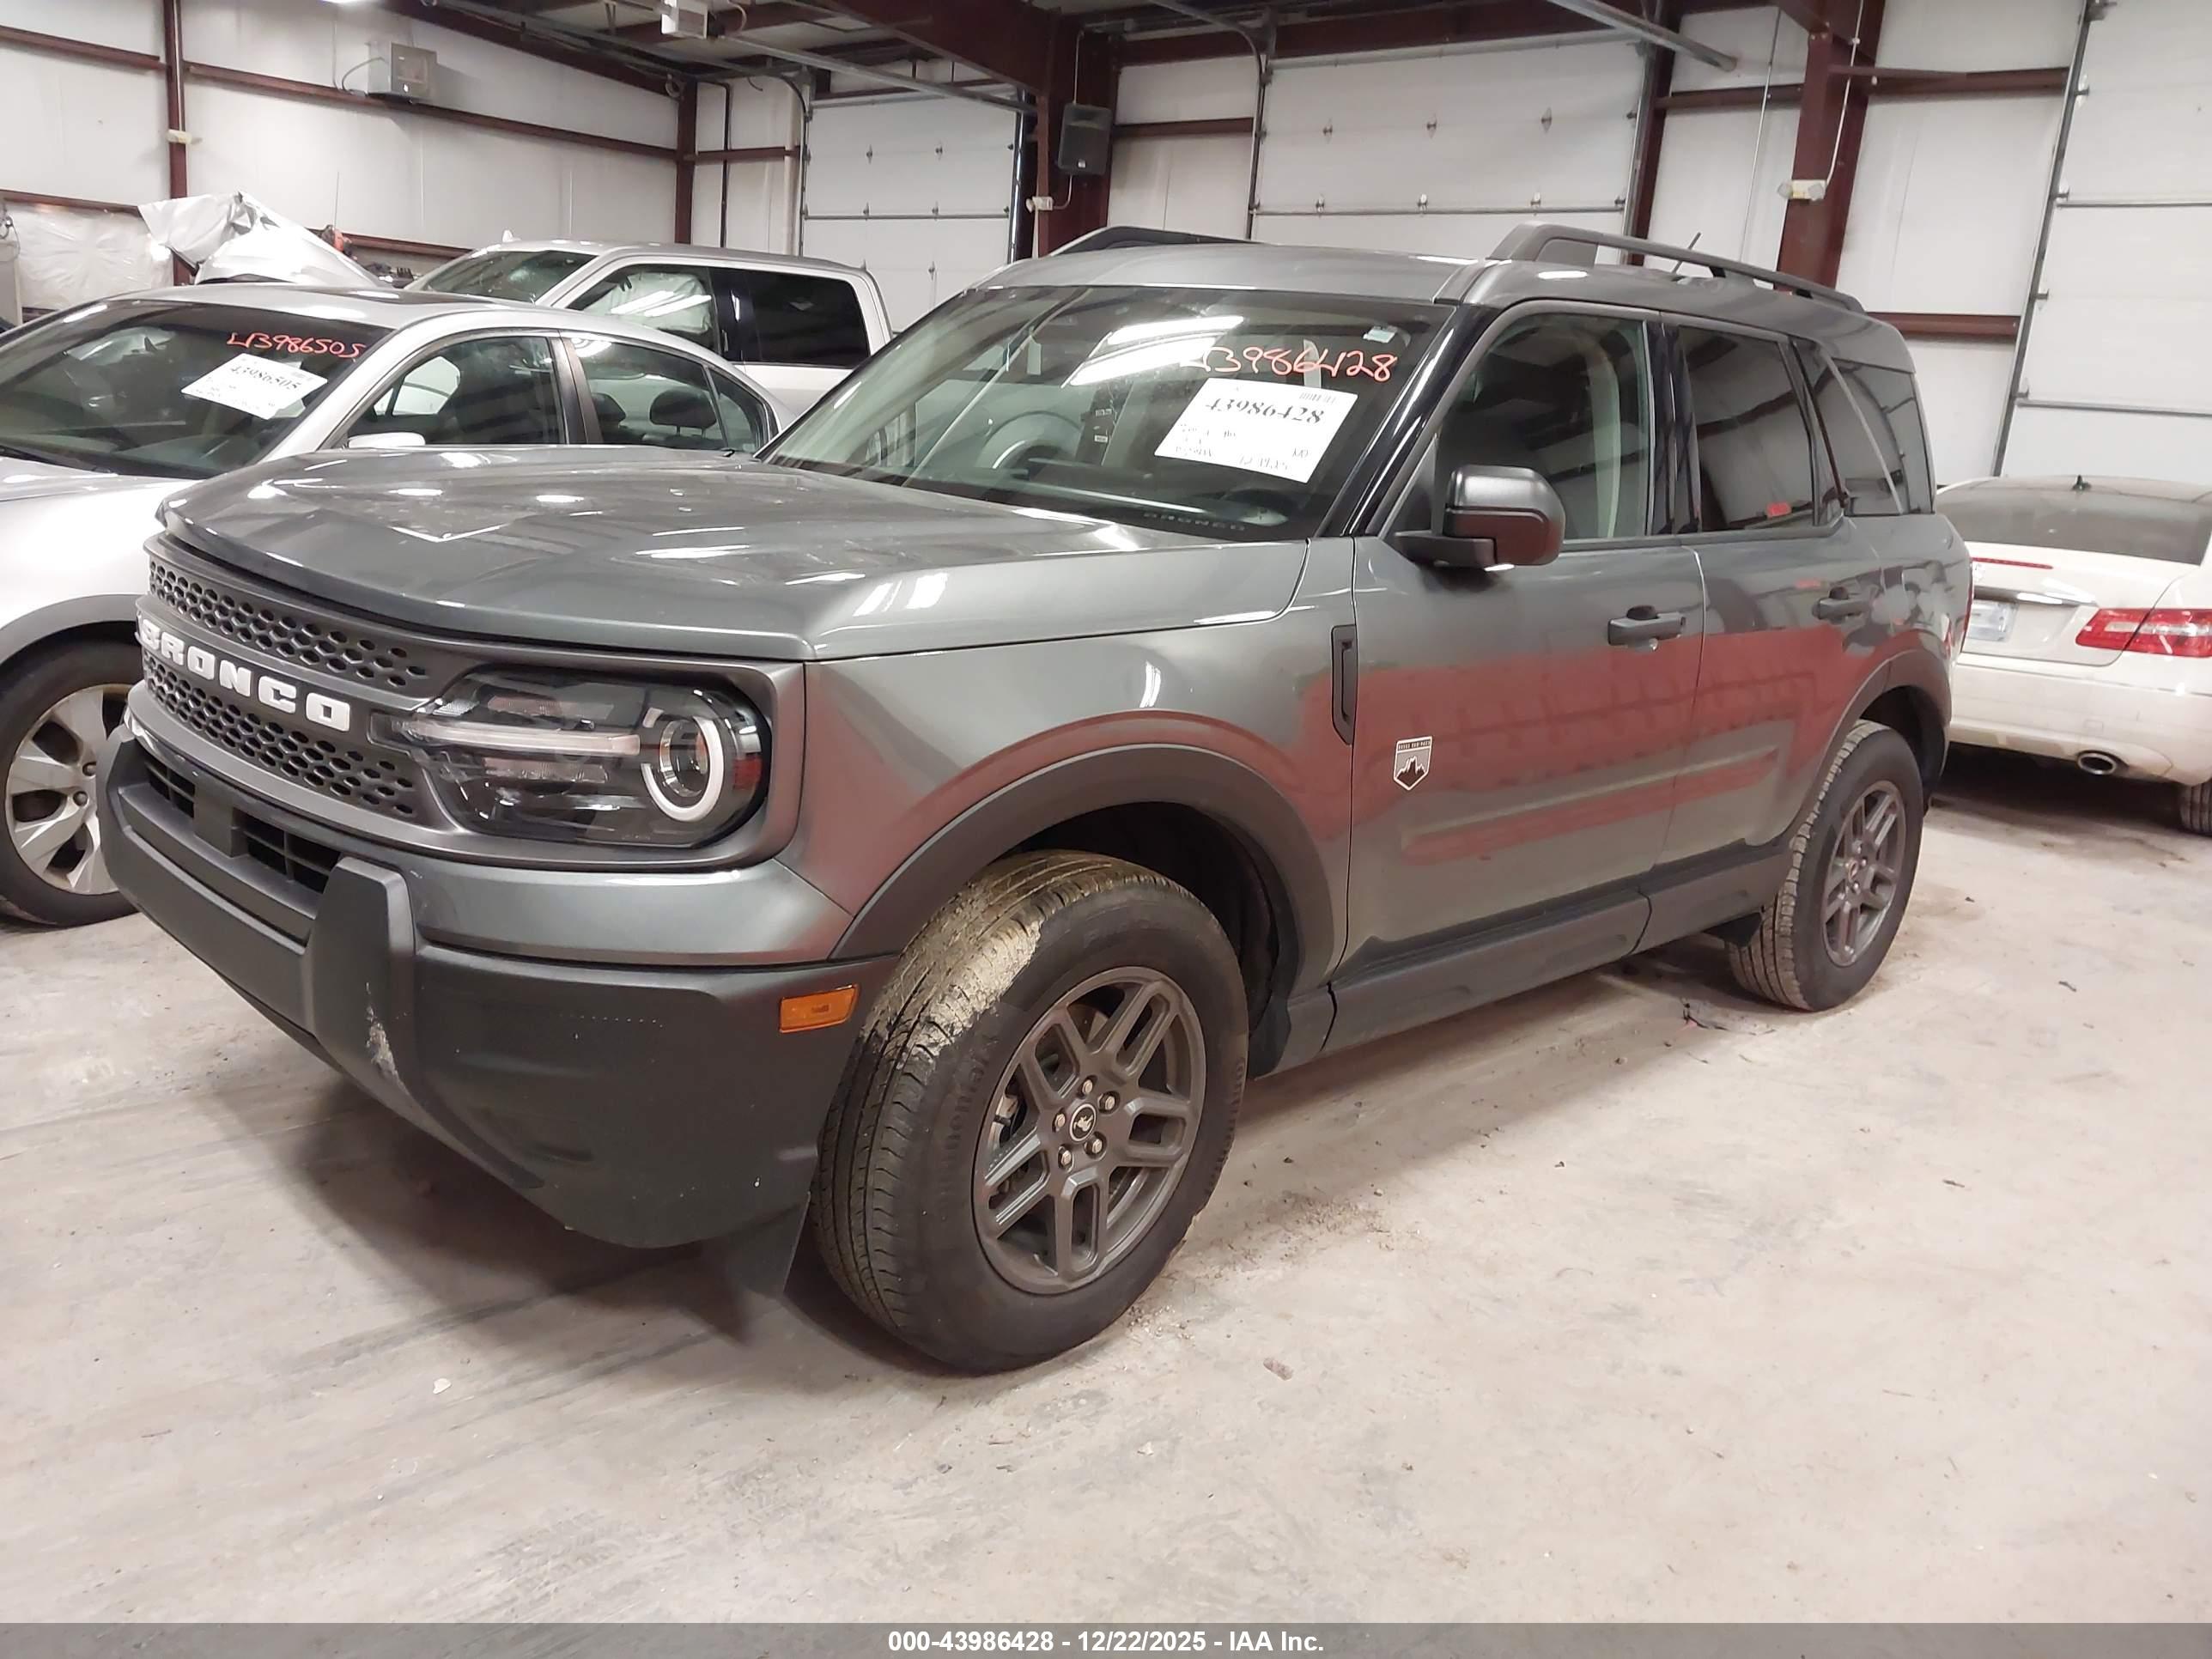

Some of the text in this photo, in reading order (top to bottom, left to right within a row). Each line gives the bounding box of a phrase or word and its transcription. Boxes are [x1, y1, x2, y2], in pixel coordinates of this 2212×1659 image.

[226, 331, 367, 358] 43986505
[1179, 345, 1399, 382] 43986428
[1204, 398, 1326, 424] 43986428
[140, 618, 351, 732] BRONCO
